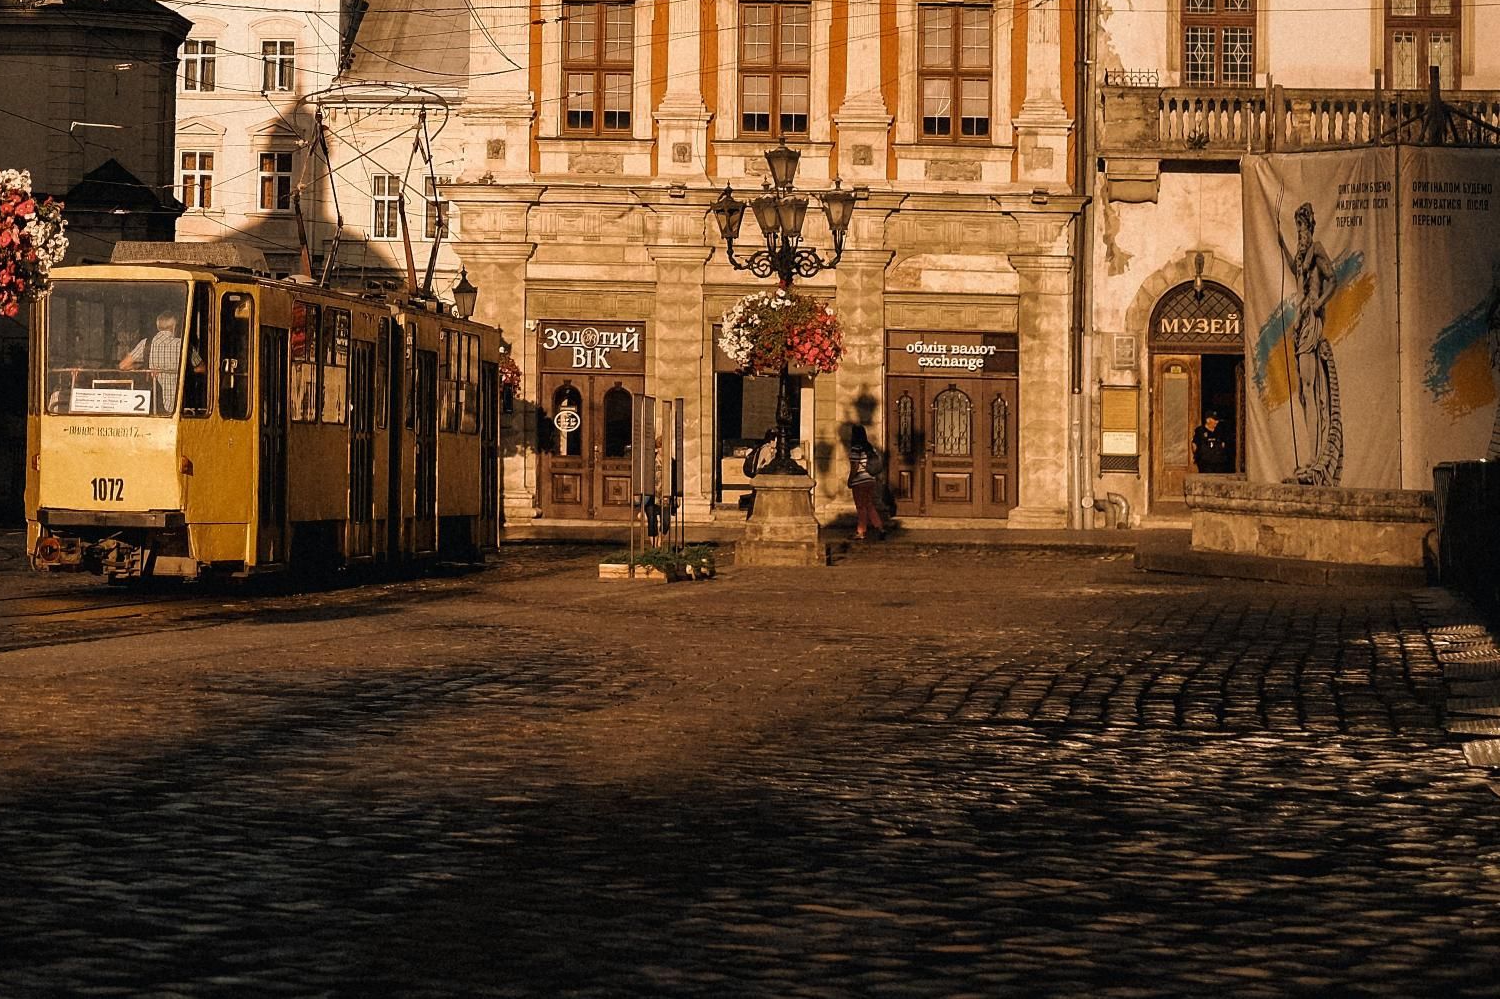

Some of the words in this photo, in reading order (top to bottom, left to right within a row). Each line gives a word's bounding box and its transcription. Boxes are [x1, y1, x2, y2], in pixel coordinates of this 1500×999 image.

[1412, 181, 1460, 193] ОРИГІНАЛОМ
[1462, 183, 1493, 194] БУДЕМО
[1412, 198, 1461, 210] МИЛУВАТИСЯ
[1412, 214, 1452, 226] ПЕРЕМОГИ
[1161, 313, 1240, 335] МУЗЕЙ
[906, 341, 948, 354] обмін
[950, 344, 997, 355] валют
[572, 346, 612, 369] ВІК
[918, 355, 985, 371] exchange
[133, 394, 146, 411] 2
[91, 477, 124, 501] 1072
